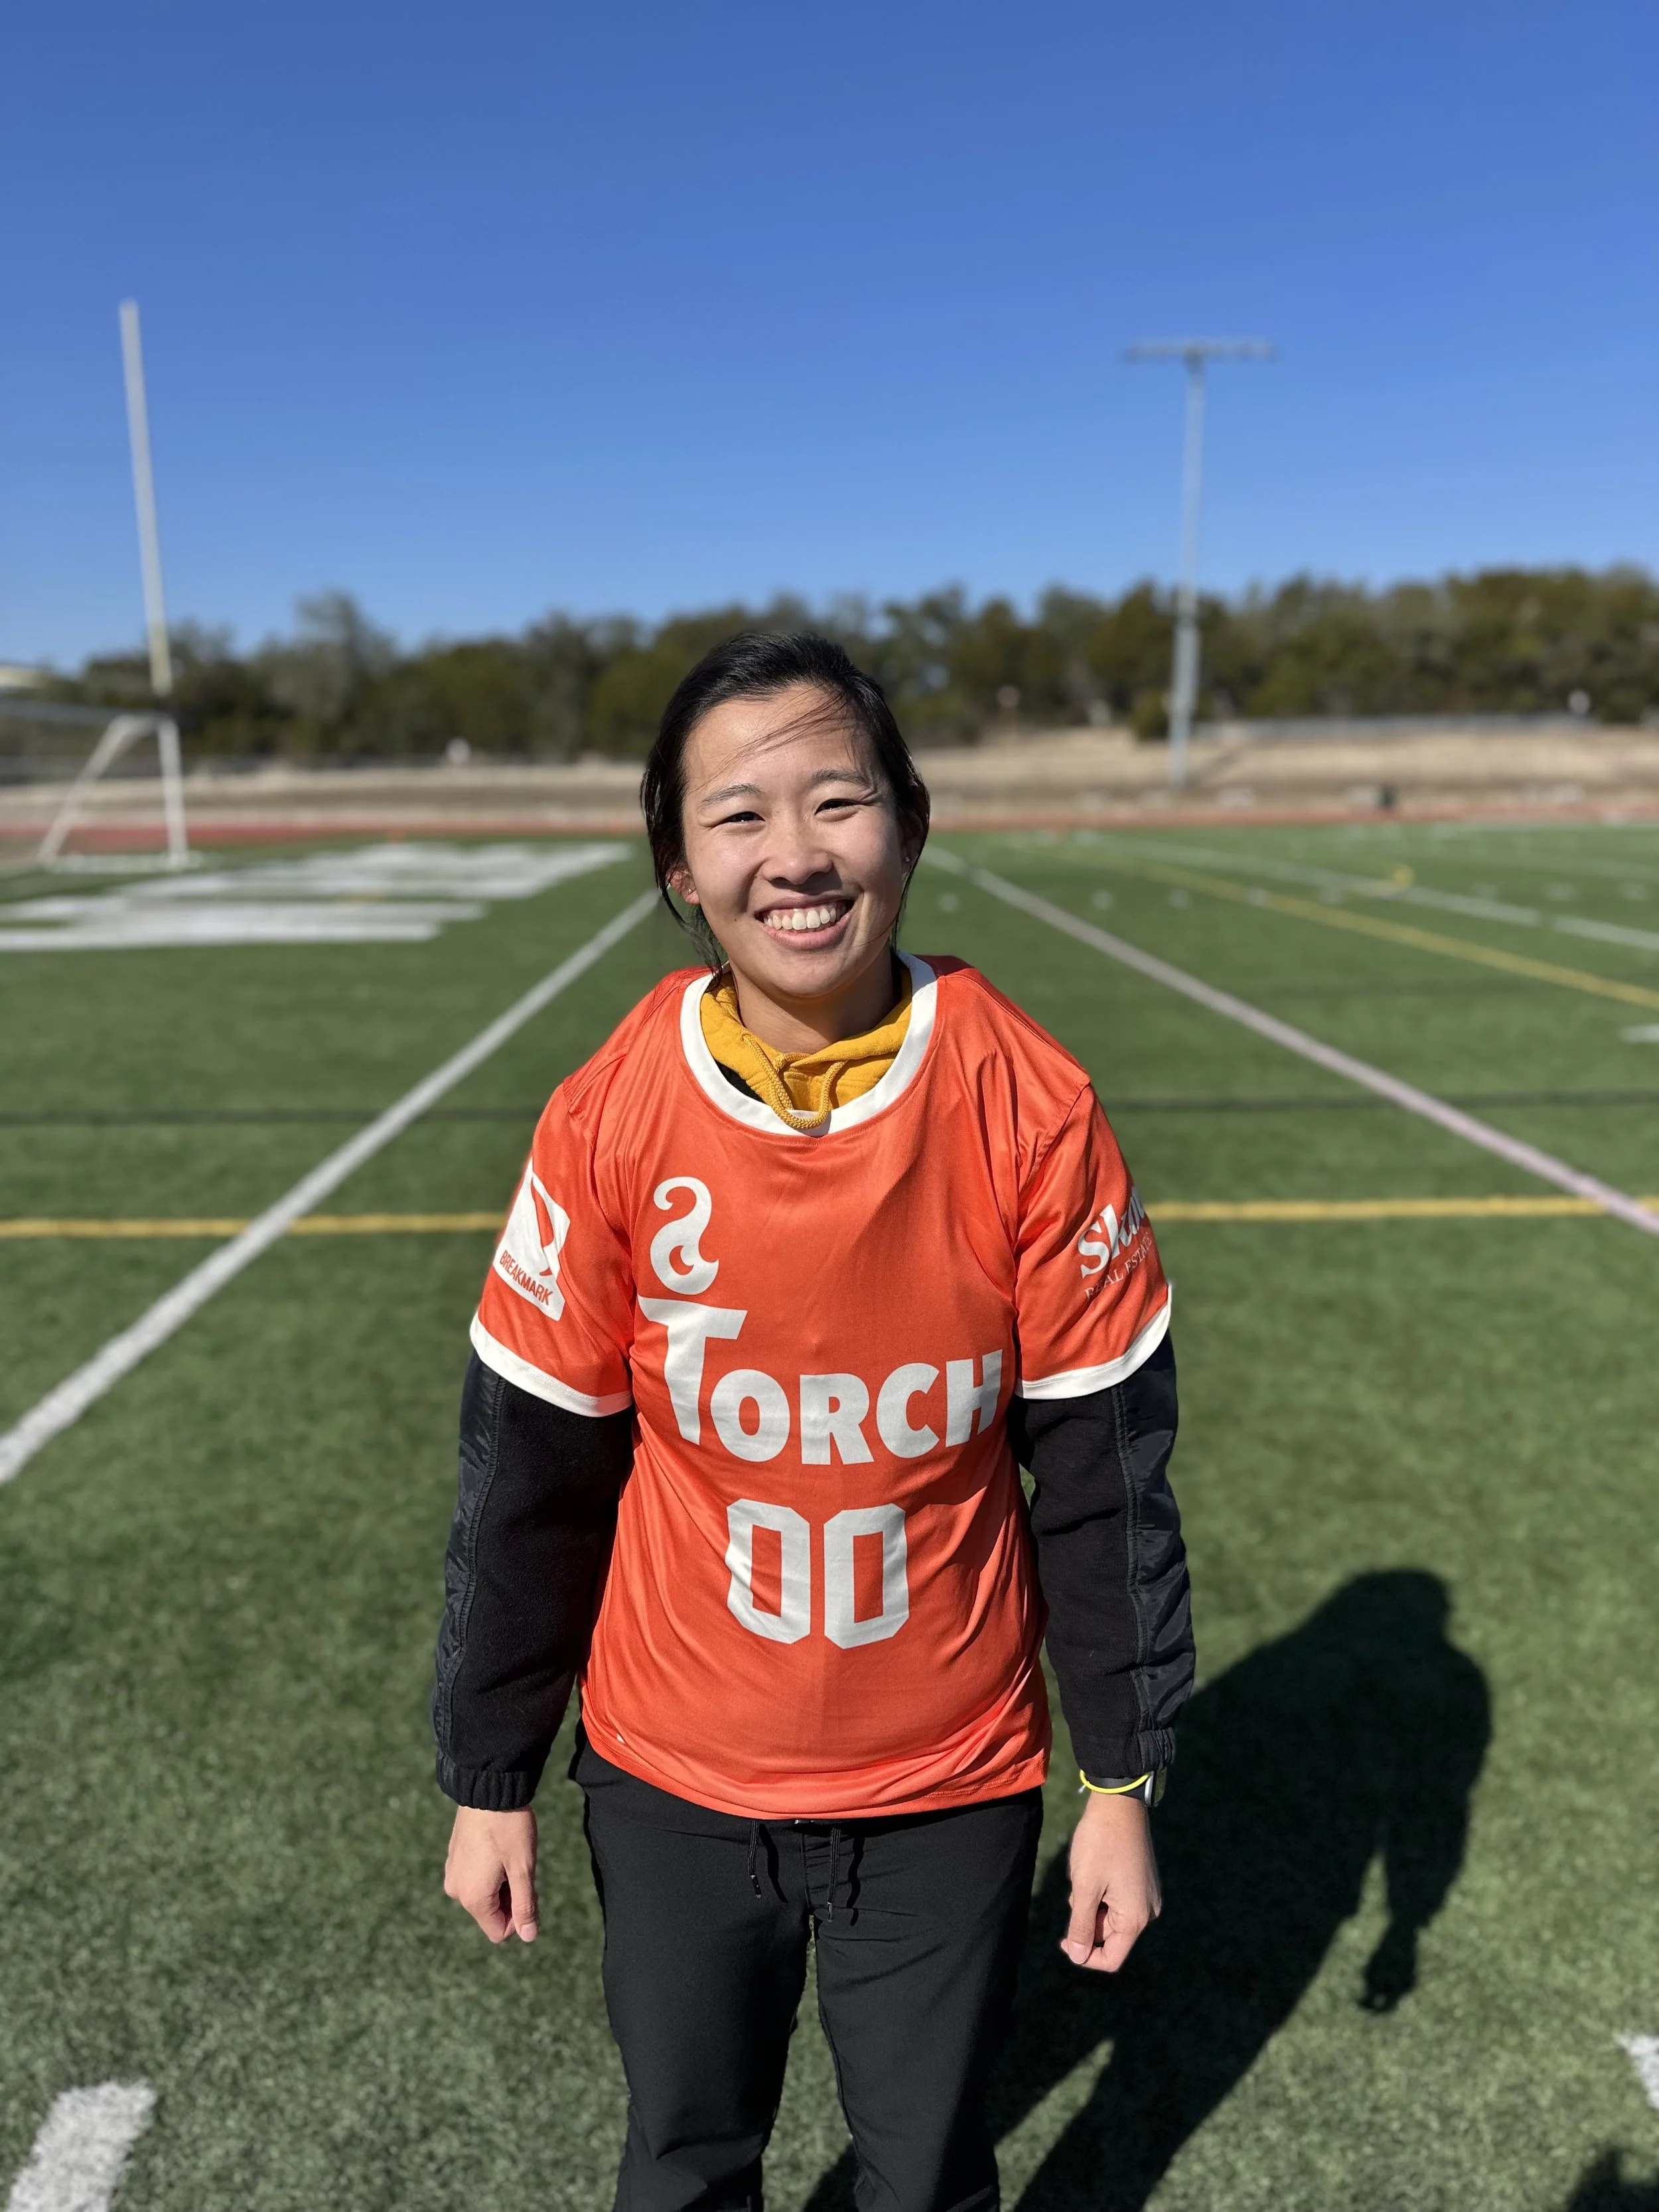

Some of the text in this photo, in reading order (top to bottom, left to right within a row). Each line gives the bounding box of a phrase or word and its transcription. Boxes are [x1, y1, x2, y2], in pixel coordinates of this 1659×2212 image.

[499, 1249, 553, 1306] BREAKMARK
[1084, 1232, 1153, 1300] REAL ESTATE
[637, 1296, 1003, 1465] TORCH
[725, 1498, 910, 1649] 00
